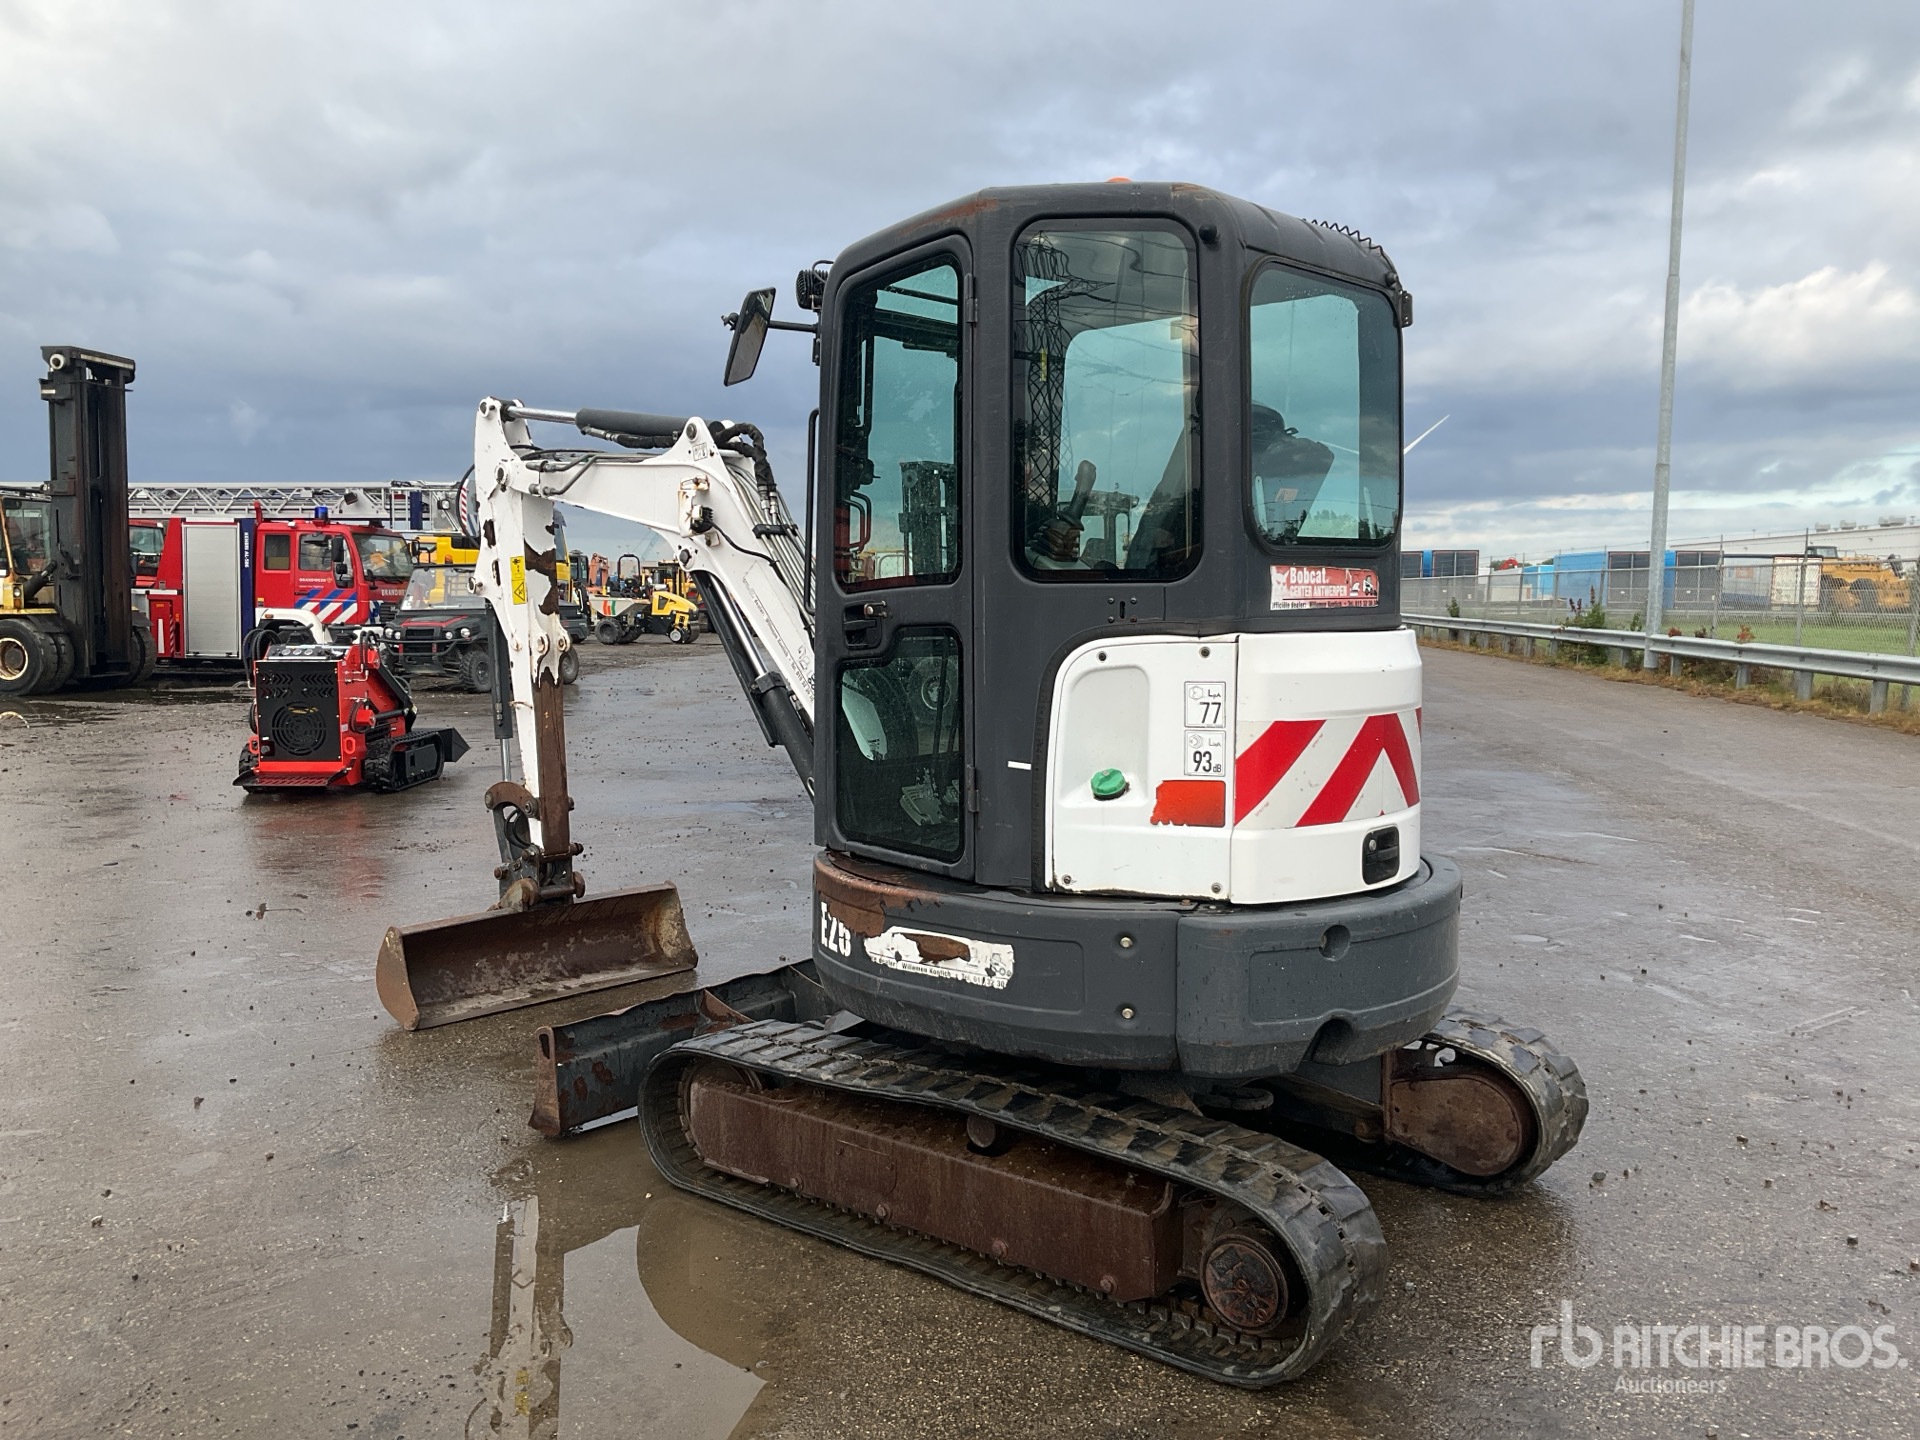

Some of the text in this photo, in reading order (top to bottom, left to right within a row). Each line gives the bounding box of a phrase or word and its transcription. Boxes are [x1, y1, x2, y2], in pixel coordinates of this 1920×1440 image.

[1289, 585, 1347, 597] CENTER ANTWERPEN
[1200, 702, 1221, 724] 77
[1193, 750, 1212, 772] 93
[902, 962, 928, 973] Willemen
